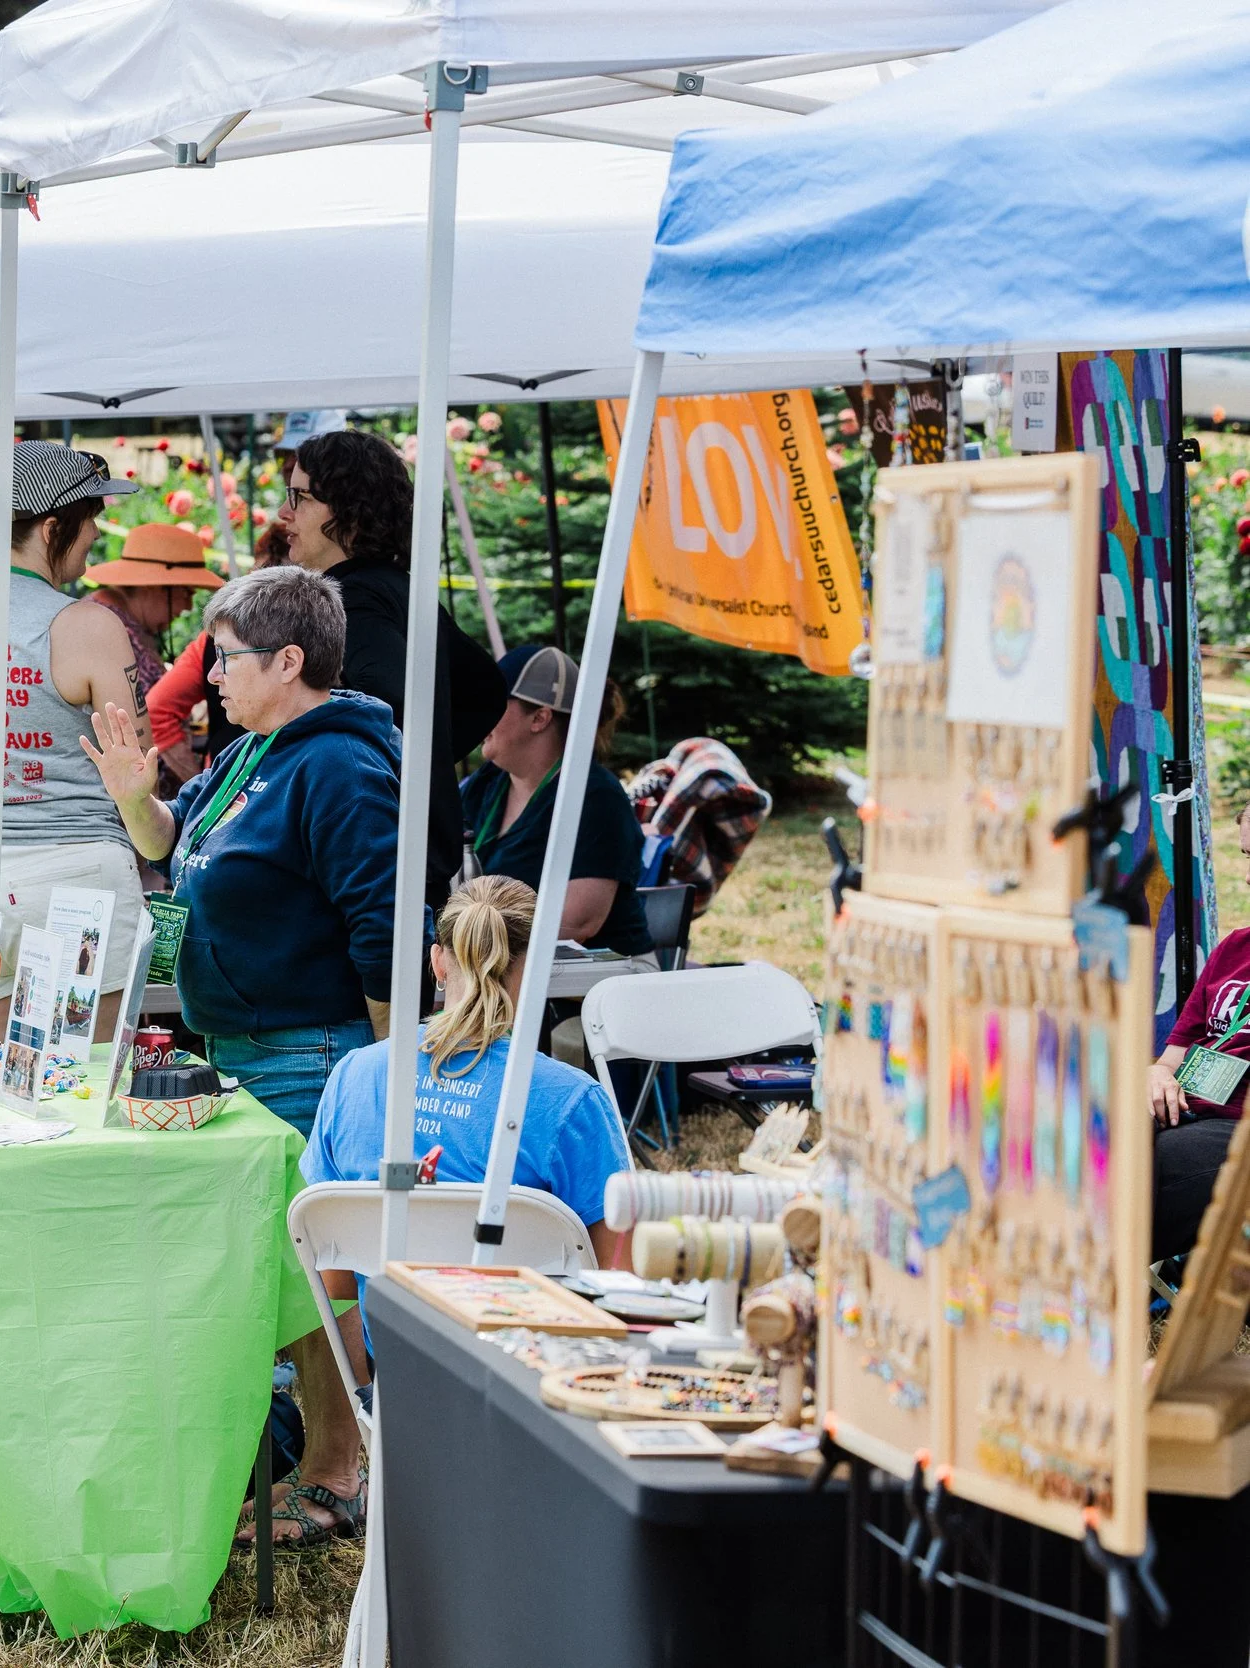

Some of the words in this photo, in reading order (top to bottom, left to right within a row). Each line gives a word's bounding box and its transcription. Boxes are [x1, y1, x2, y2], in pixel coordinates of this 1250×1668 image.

[658, 415, 803, 581] LOV
[772, 391, 842, 615] cedarsuuchurch.org
[248, 776, 269, 793] in
[133, 1051, 159, 1071] pper
[135, 1045, 148, 1058] Dr
[421, 1075, 434, 1090] IN
[437, 1077, 482, 1099] CONCERT
[415, 1096, 440, 1114] MBER
[442, 1100, 471, 1120] CAMP
[416, 1117, 442, 1136] 2024
